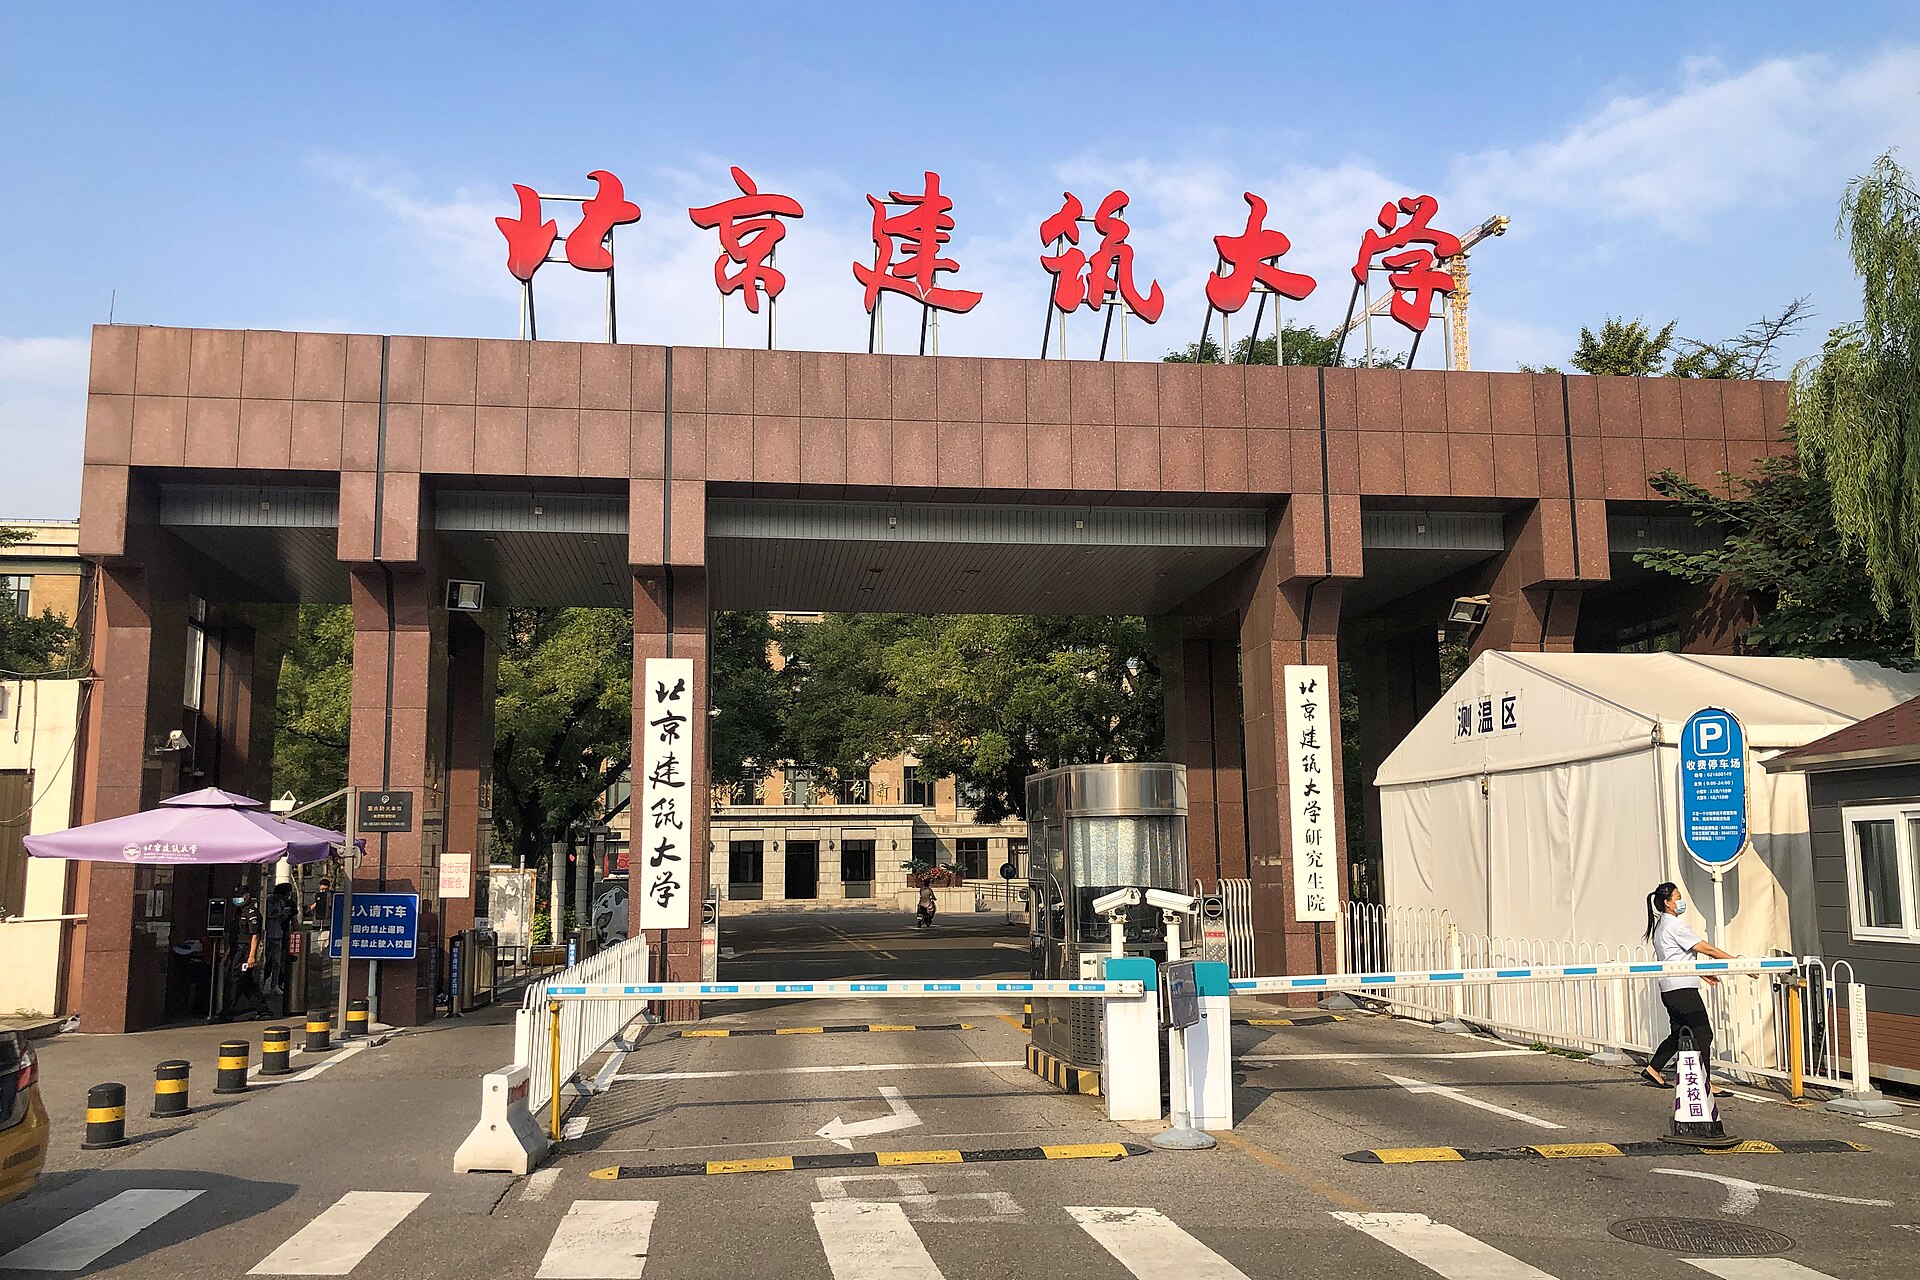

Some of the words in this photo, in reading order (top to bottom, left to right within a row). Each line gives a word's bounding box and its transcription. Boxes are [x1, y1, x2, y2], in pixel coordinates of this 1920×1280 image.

[495, 166, 1462, 330] 北京建筑大学
[1456, 695, 1518, 738] 测温区
[1700, 722, 1723, 750] P
[1686, 758, 1741, 770] 收费停车场
[648, 678, 687, 909] 北京建筑大学
[1298, 678, 1327, 913] 北京建筑大学研究生院
[143, 843, 198, 854] 北京建筑大学
[351, 905, 407, 918] 入请下车
[334, 939, 413, 949] 摩车禁止驶入校园
[1683, 1056, 1704, 1117] 平安校园
